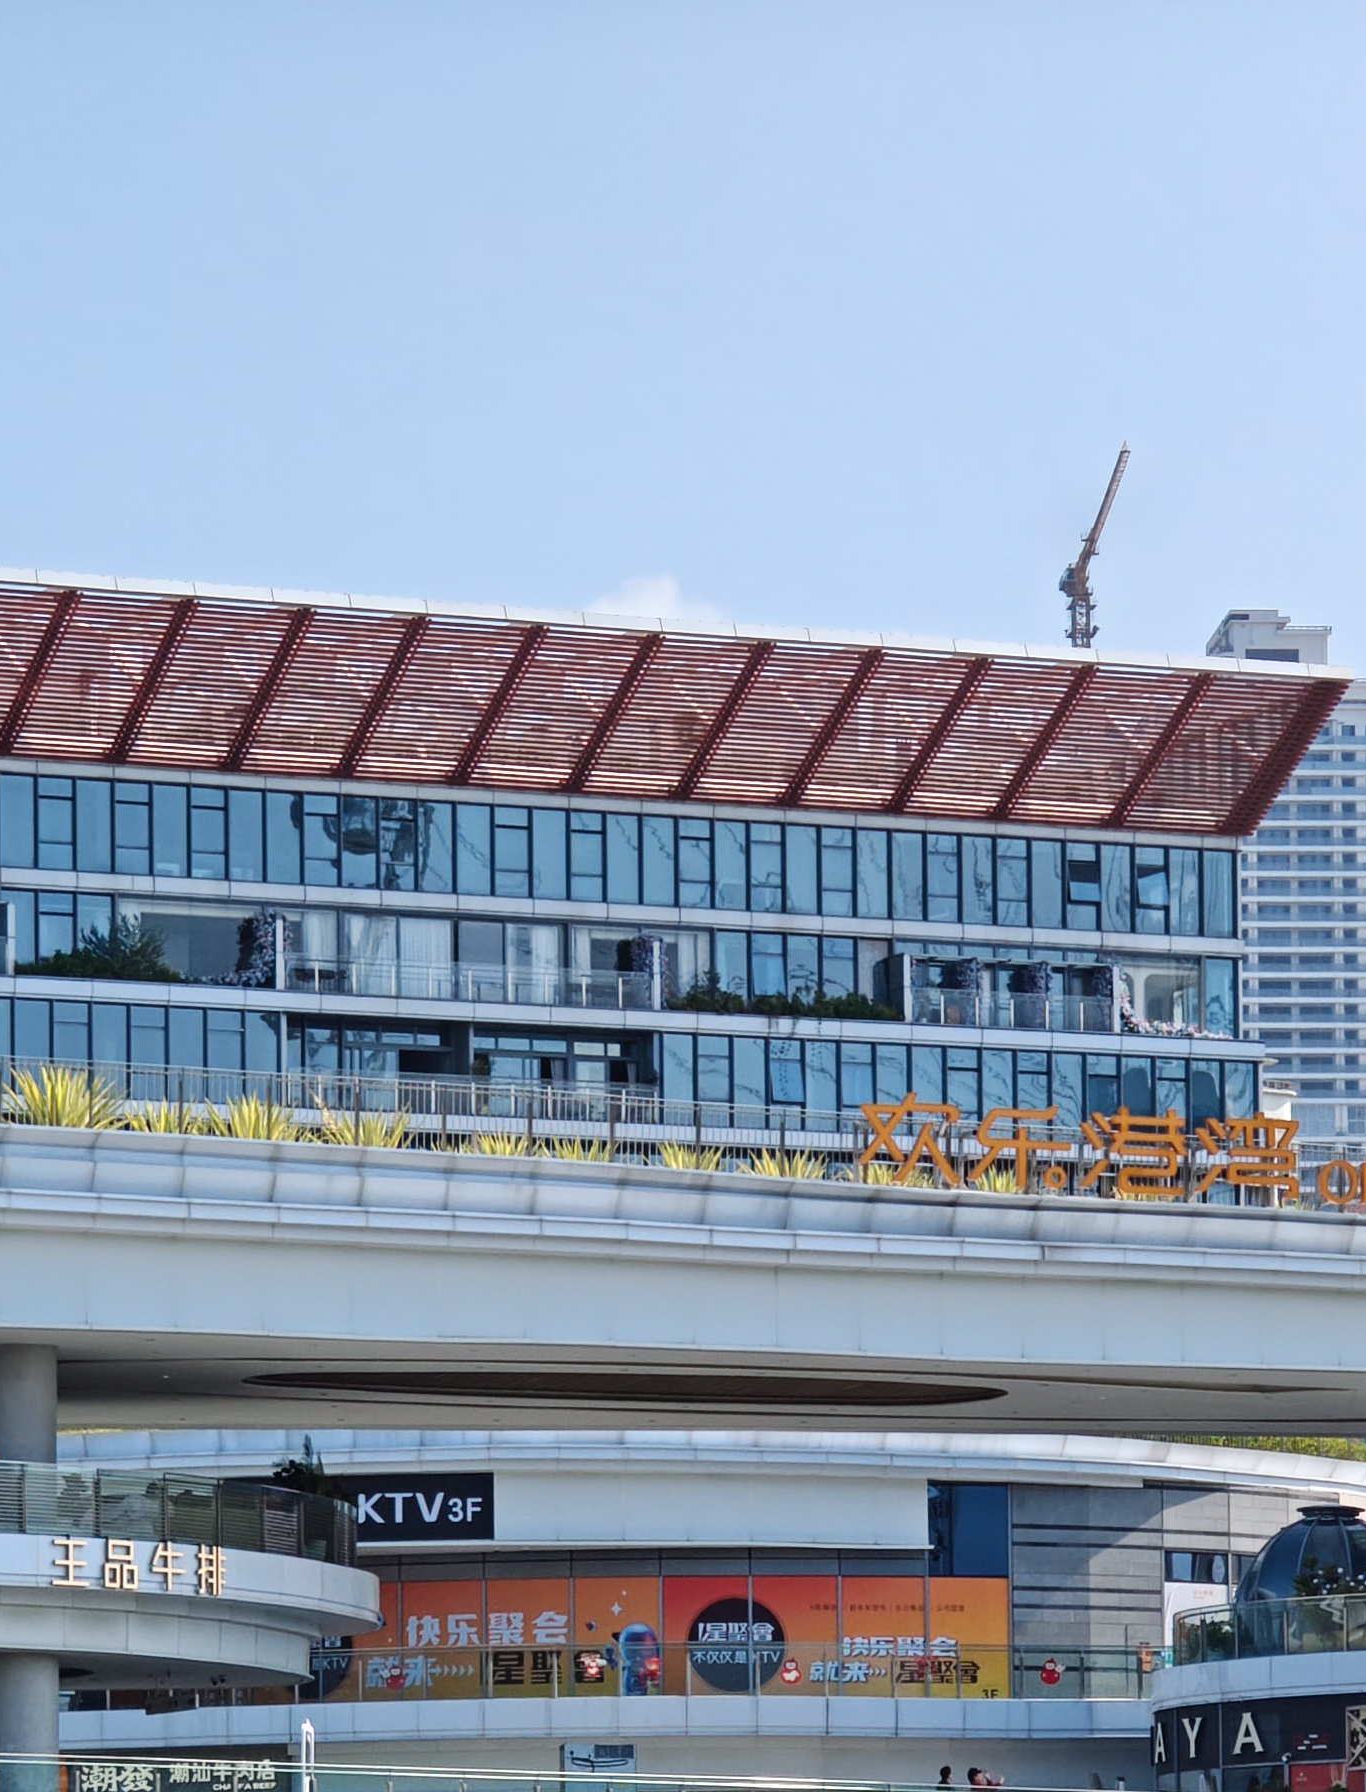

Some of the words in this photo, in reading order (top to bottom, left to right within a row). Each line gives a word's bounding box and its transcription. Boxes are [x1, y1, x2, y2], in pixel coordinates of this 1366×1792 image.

[858, 1092, 1300, 1200] 欢乐港湾
[358, 1491, 445, 1525] KTV
[447, 1497, 483, 1523] 3F
[51, 1538, 228, 1596] 王品牛排
[406, 1610, 569, 1647] 快乐聚会
[692, 1651, 781, 1664] 不仅仅是TV
[842, 1636, 958, 1657] 快乐聚会
